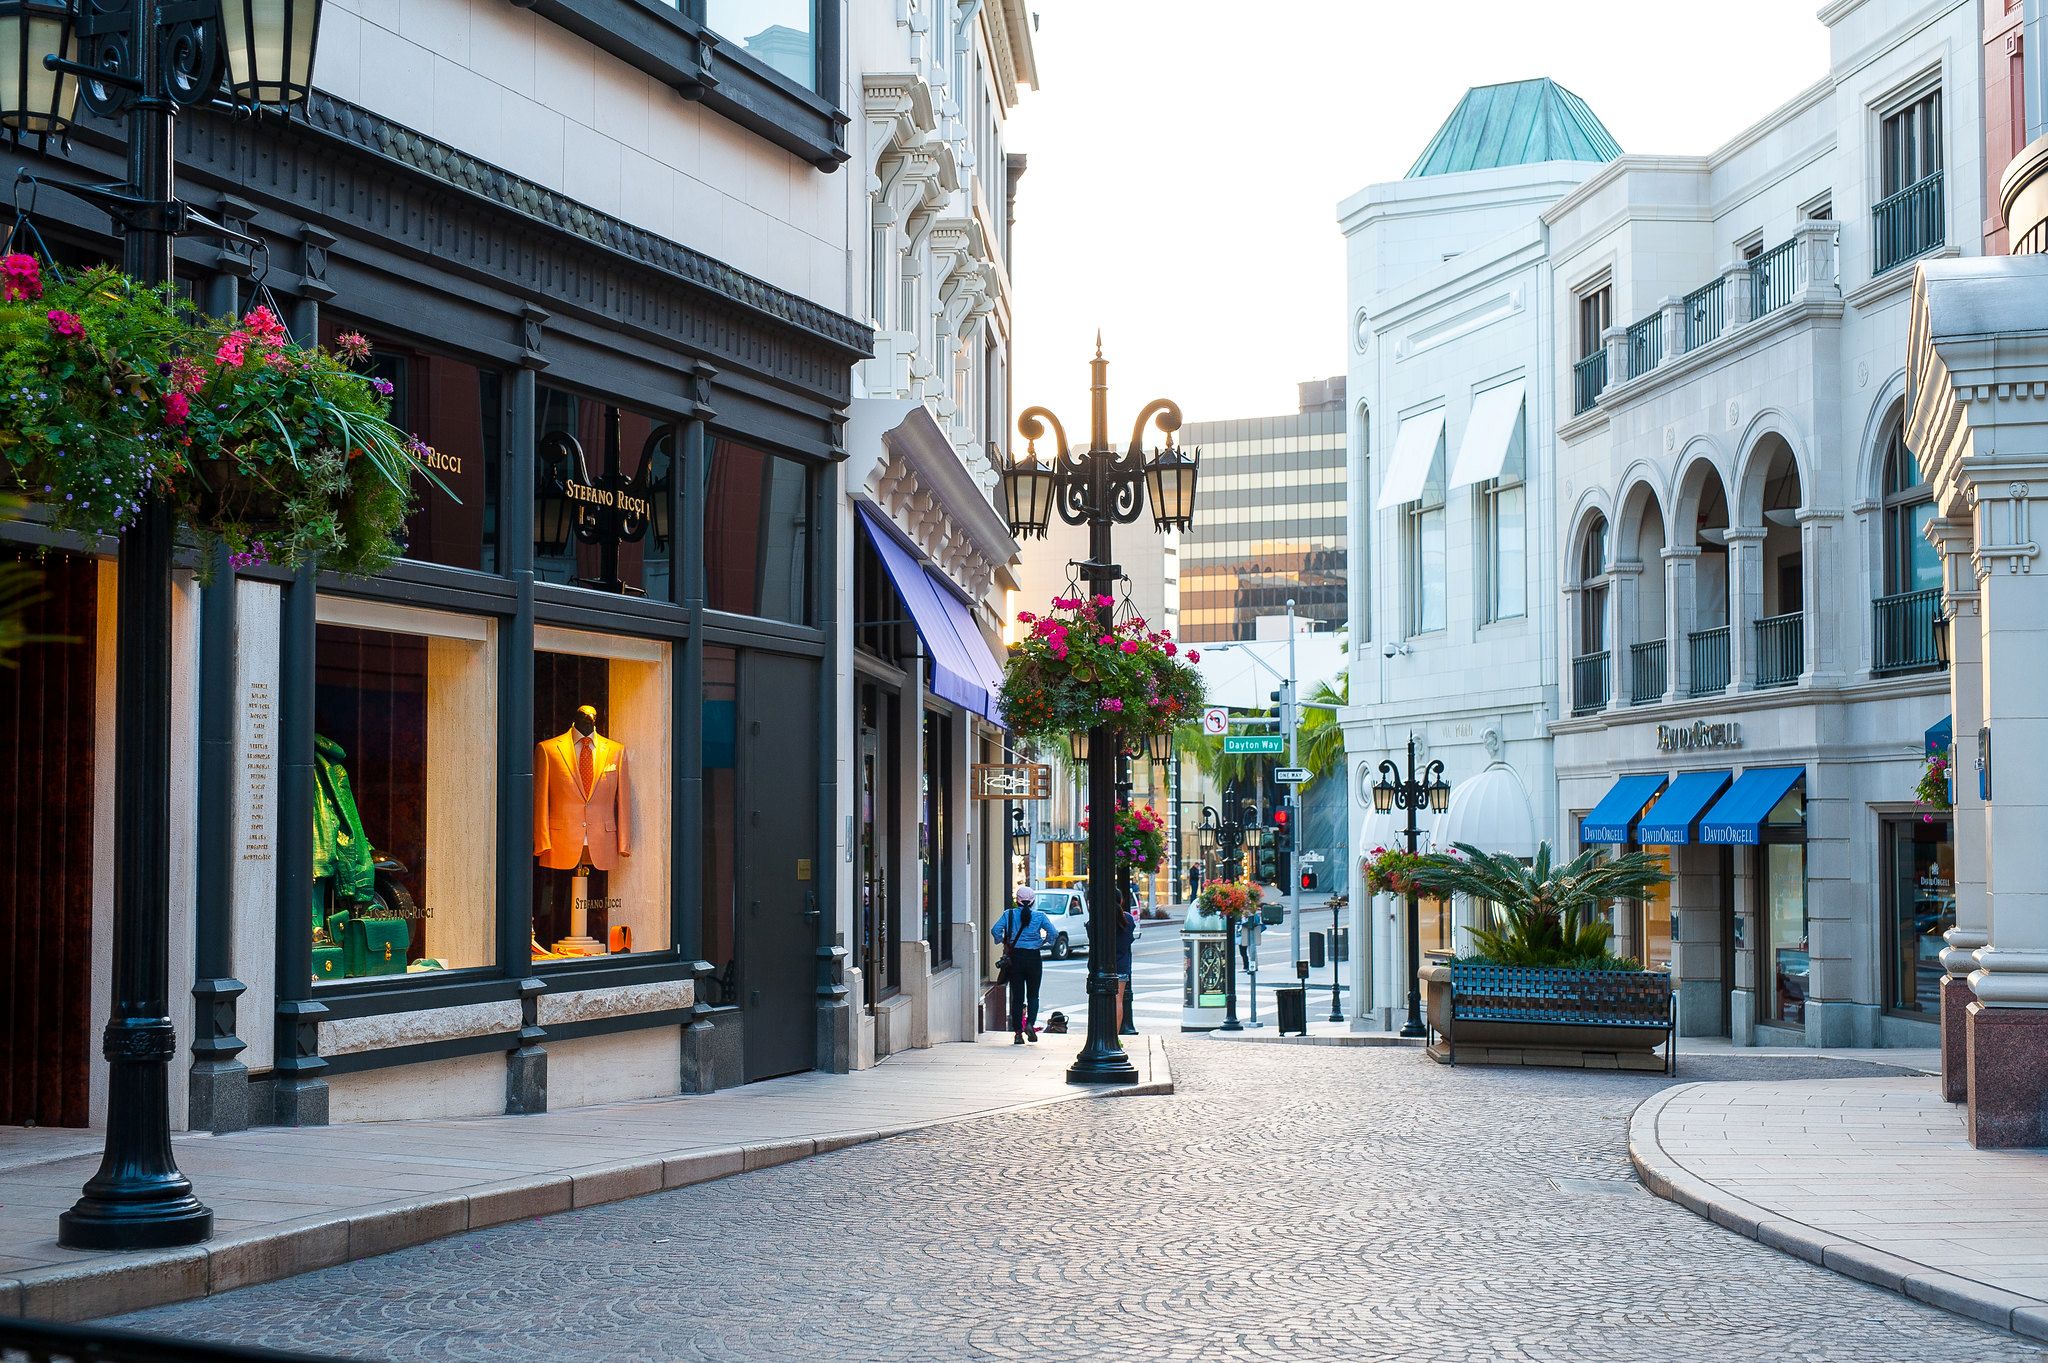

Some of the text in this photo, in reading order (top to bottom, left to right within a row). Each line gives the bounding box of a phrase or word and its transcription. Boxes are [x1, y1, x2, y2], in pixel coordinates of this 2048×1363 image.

[427, 446, 462, 474] RICCI
[566, 479, 645, 514] STEFANO RICCI
[1229, 740, 1279, 751] Dayton Way
[575, 897, 604, 910] STEFANO
[412, 905, 434, 919] RICCI
